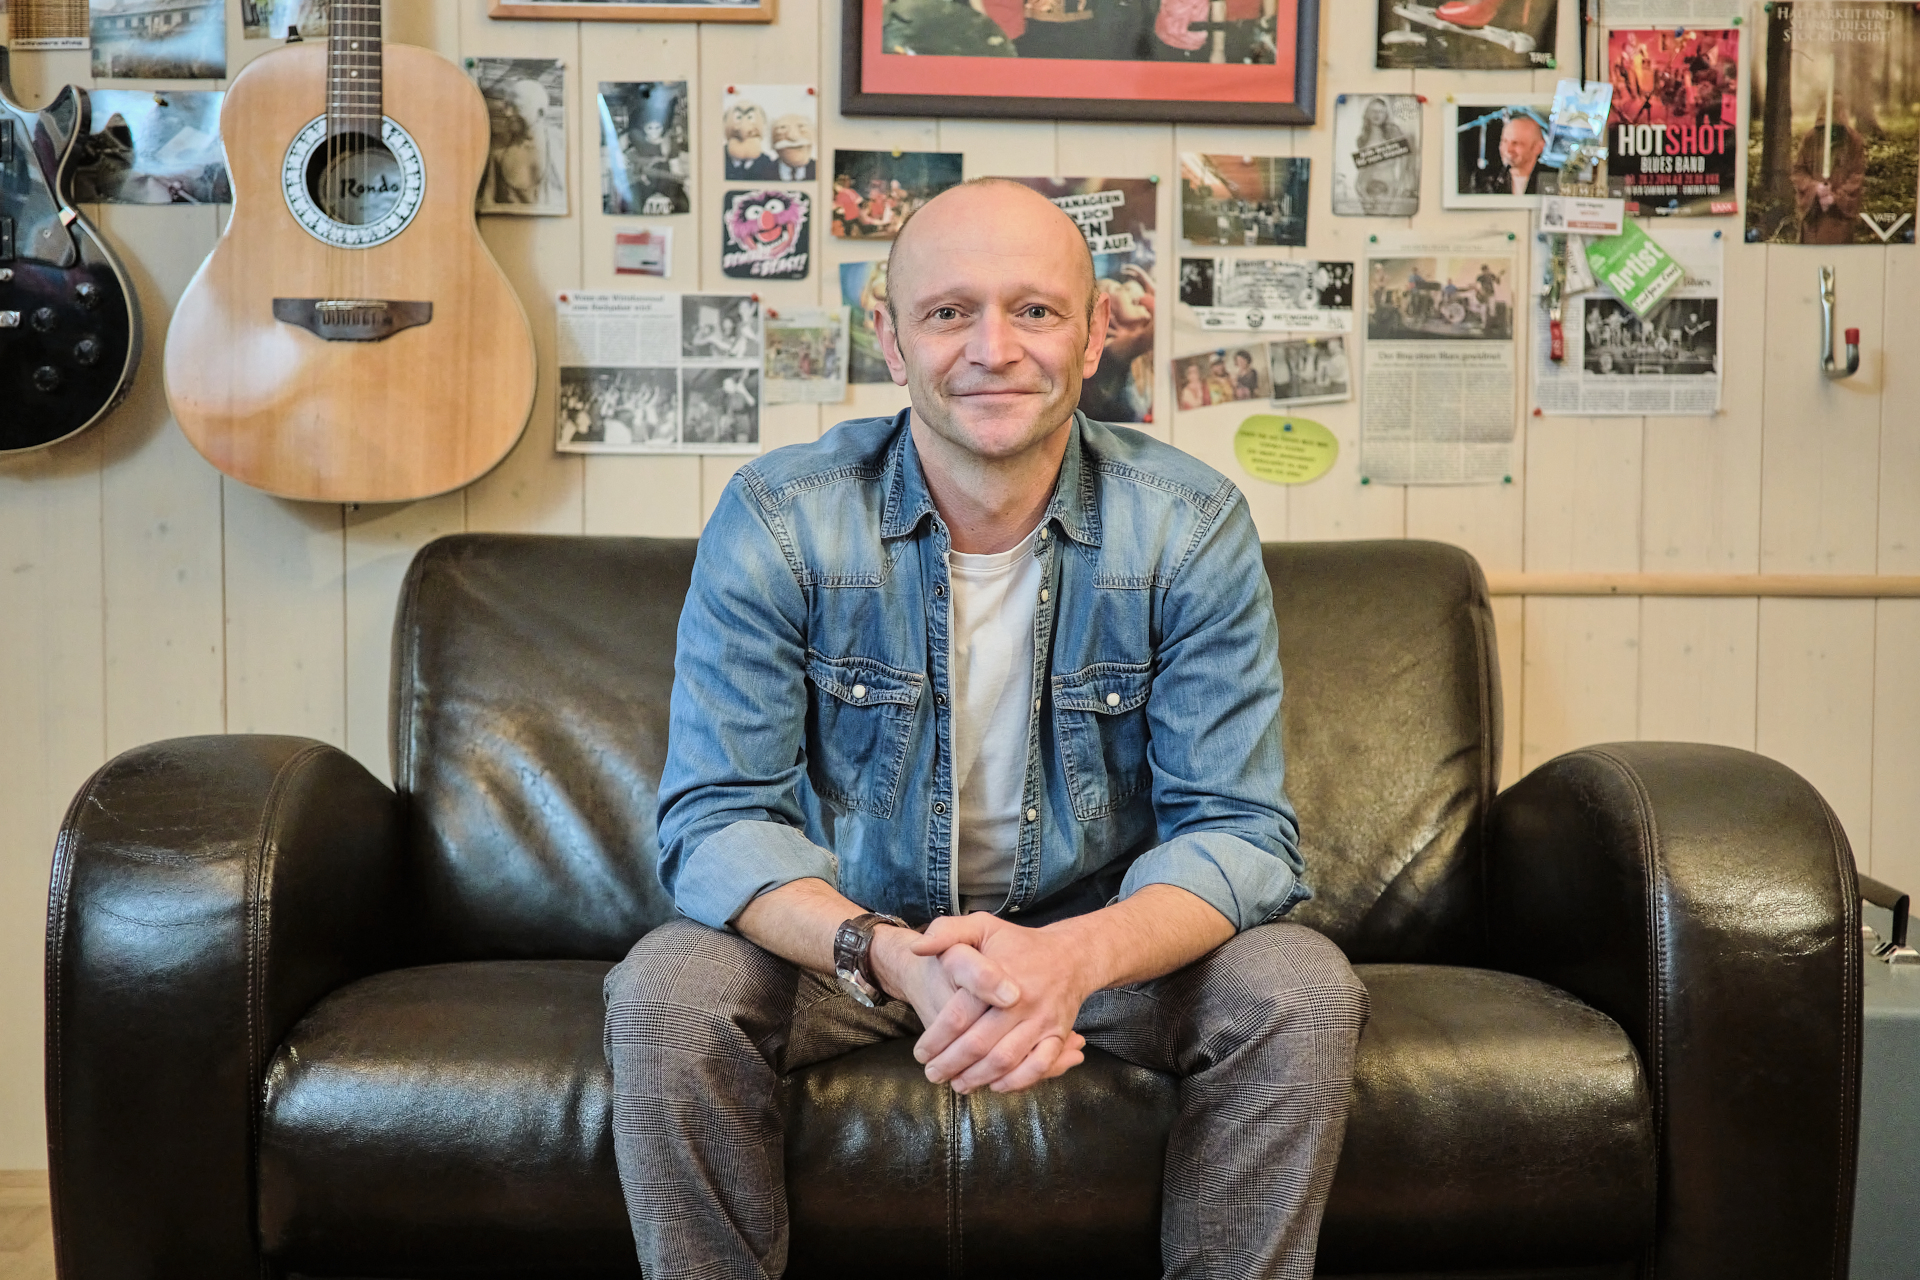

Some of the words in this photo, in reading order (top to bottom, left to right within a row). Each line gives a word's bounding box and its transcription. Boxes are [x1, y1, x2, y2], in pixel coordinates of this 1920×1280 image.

[1866, 8, 1895, 20] UND
[1640, 155, 1673, 173] BLUES
[1675, 155, 1706, 173] BAND
[340, 174, 399, 199] Rondo
[1608, 241, 1665, 297] Artist
